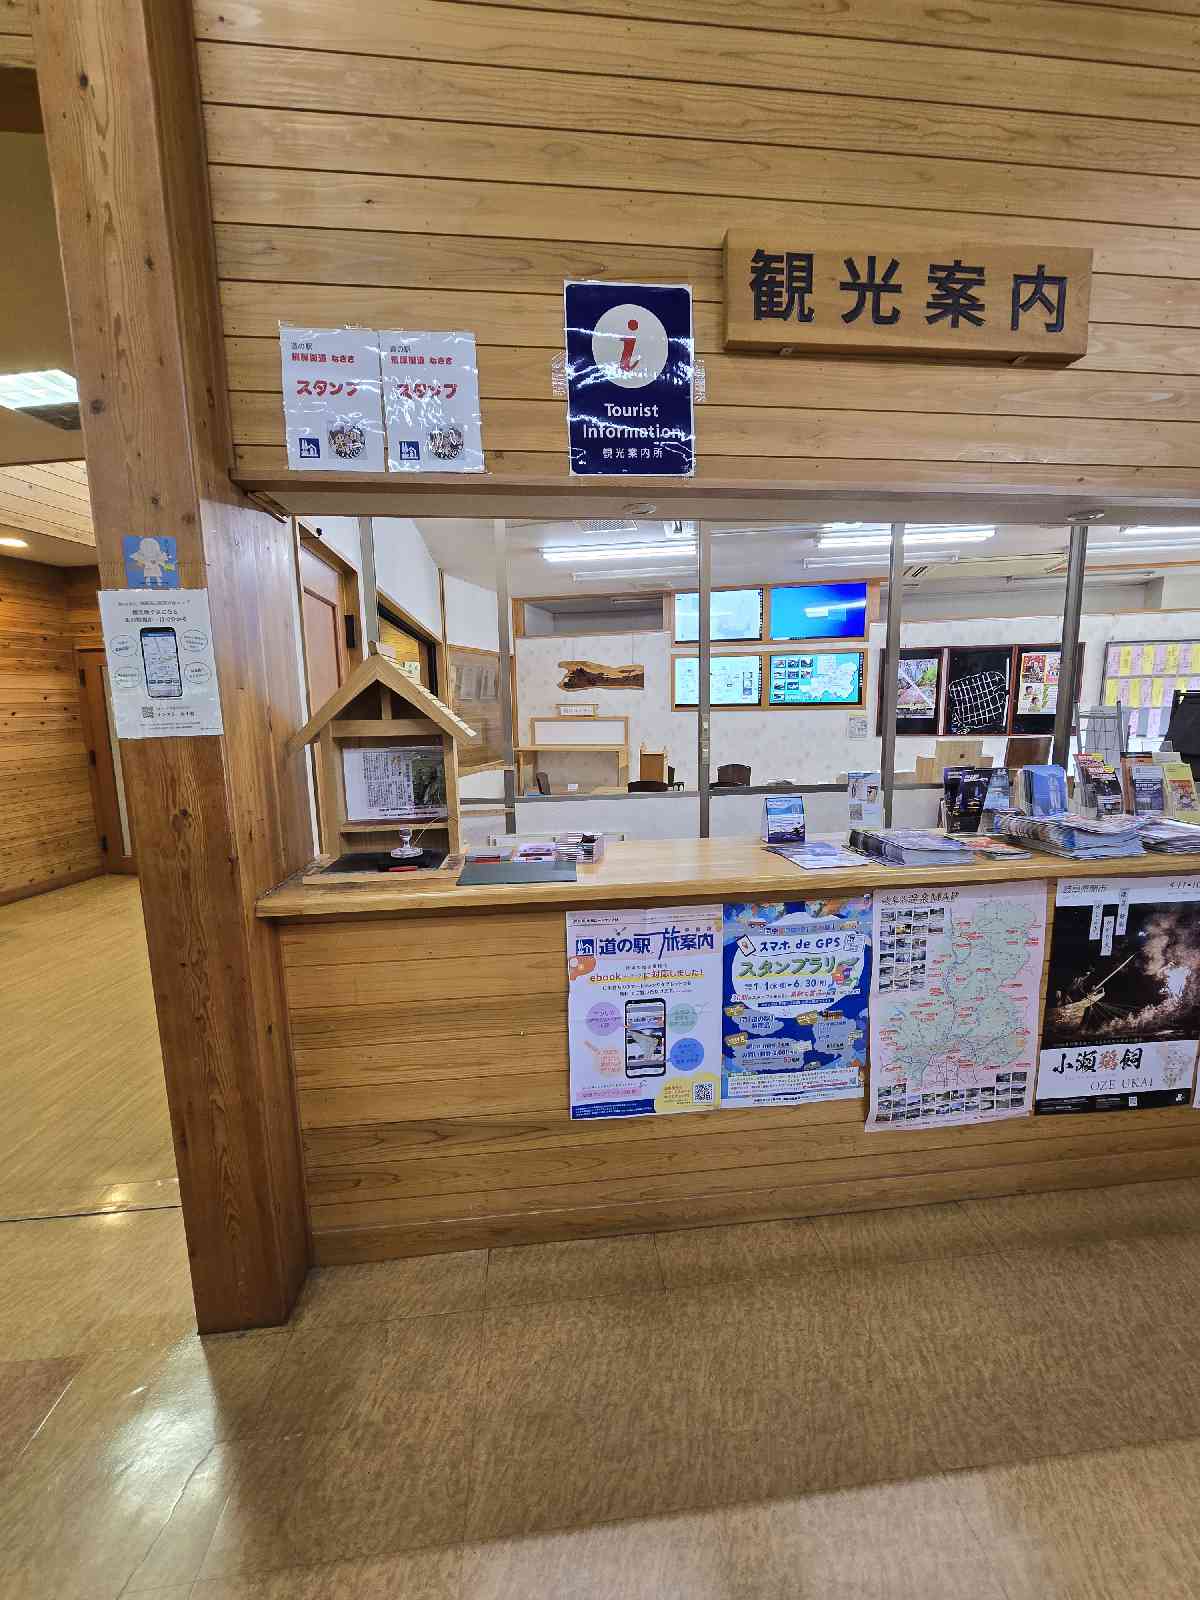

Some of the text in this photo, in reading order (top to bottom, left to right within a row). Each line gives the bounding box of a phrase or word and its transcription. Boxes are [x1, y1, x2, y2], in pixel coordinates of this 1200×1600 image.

[751, 249, 1067, 332] 観光案内
[604, 403, 660, 417] Tourist
[583, 424, 684, 439] Information
[602, 447, 663, 459] 観光案内所
[599, 937, 651, 956] 道の駅
[760, 937, 841, 953] スマホ de GPS
[738, 957, 861, 977] スタンプラリー
[1090, 1076, 1154, 1092] OZE UKAI
